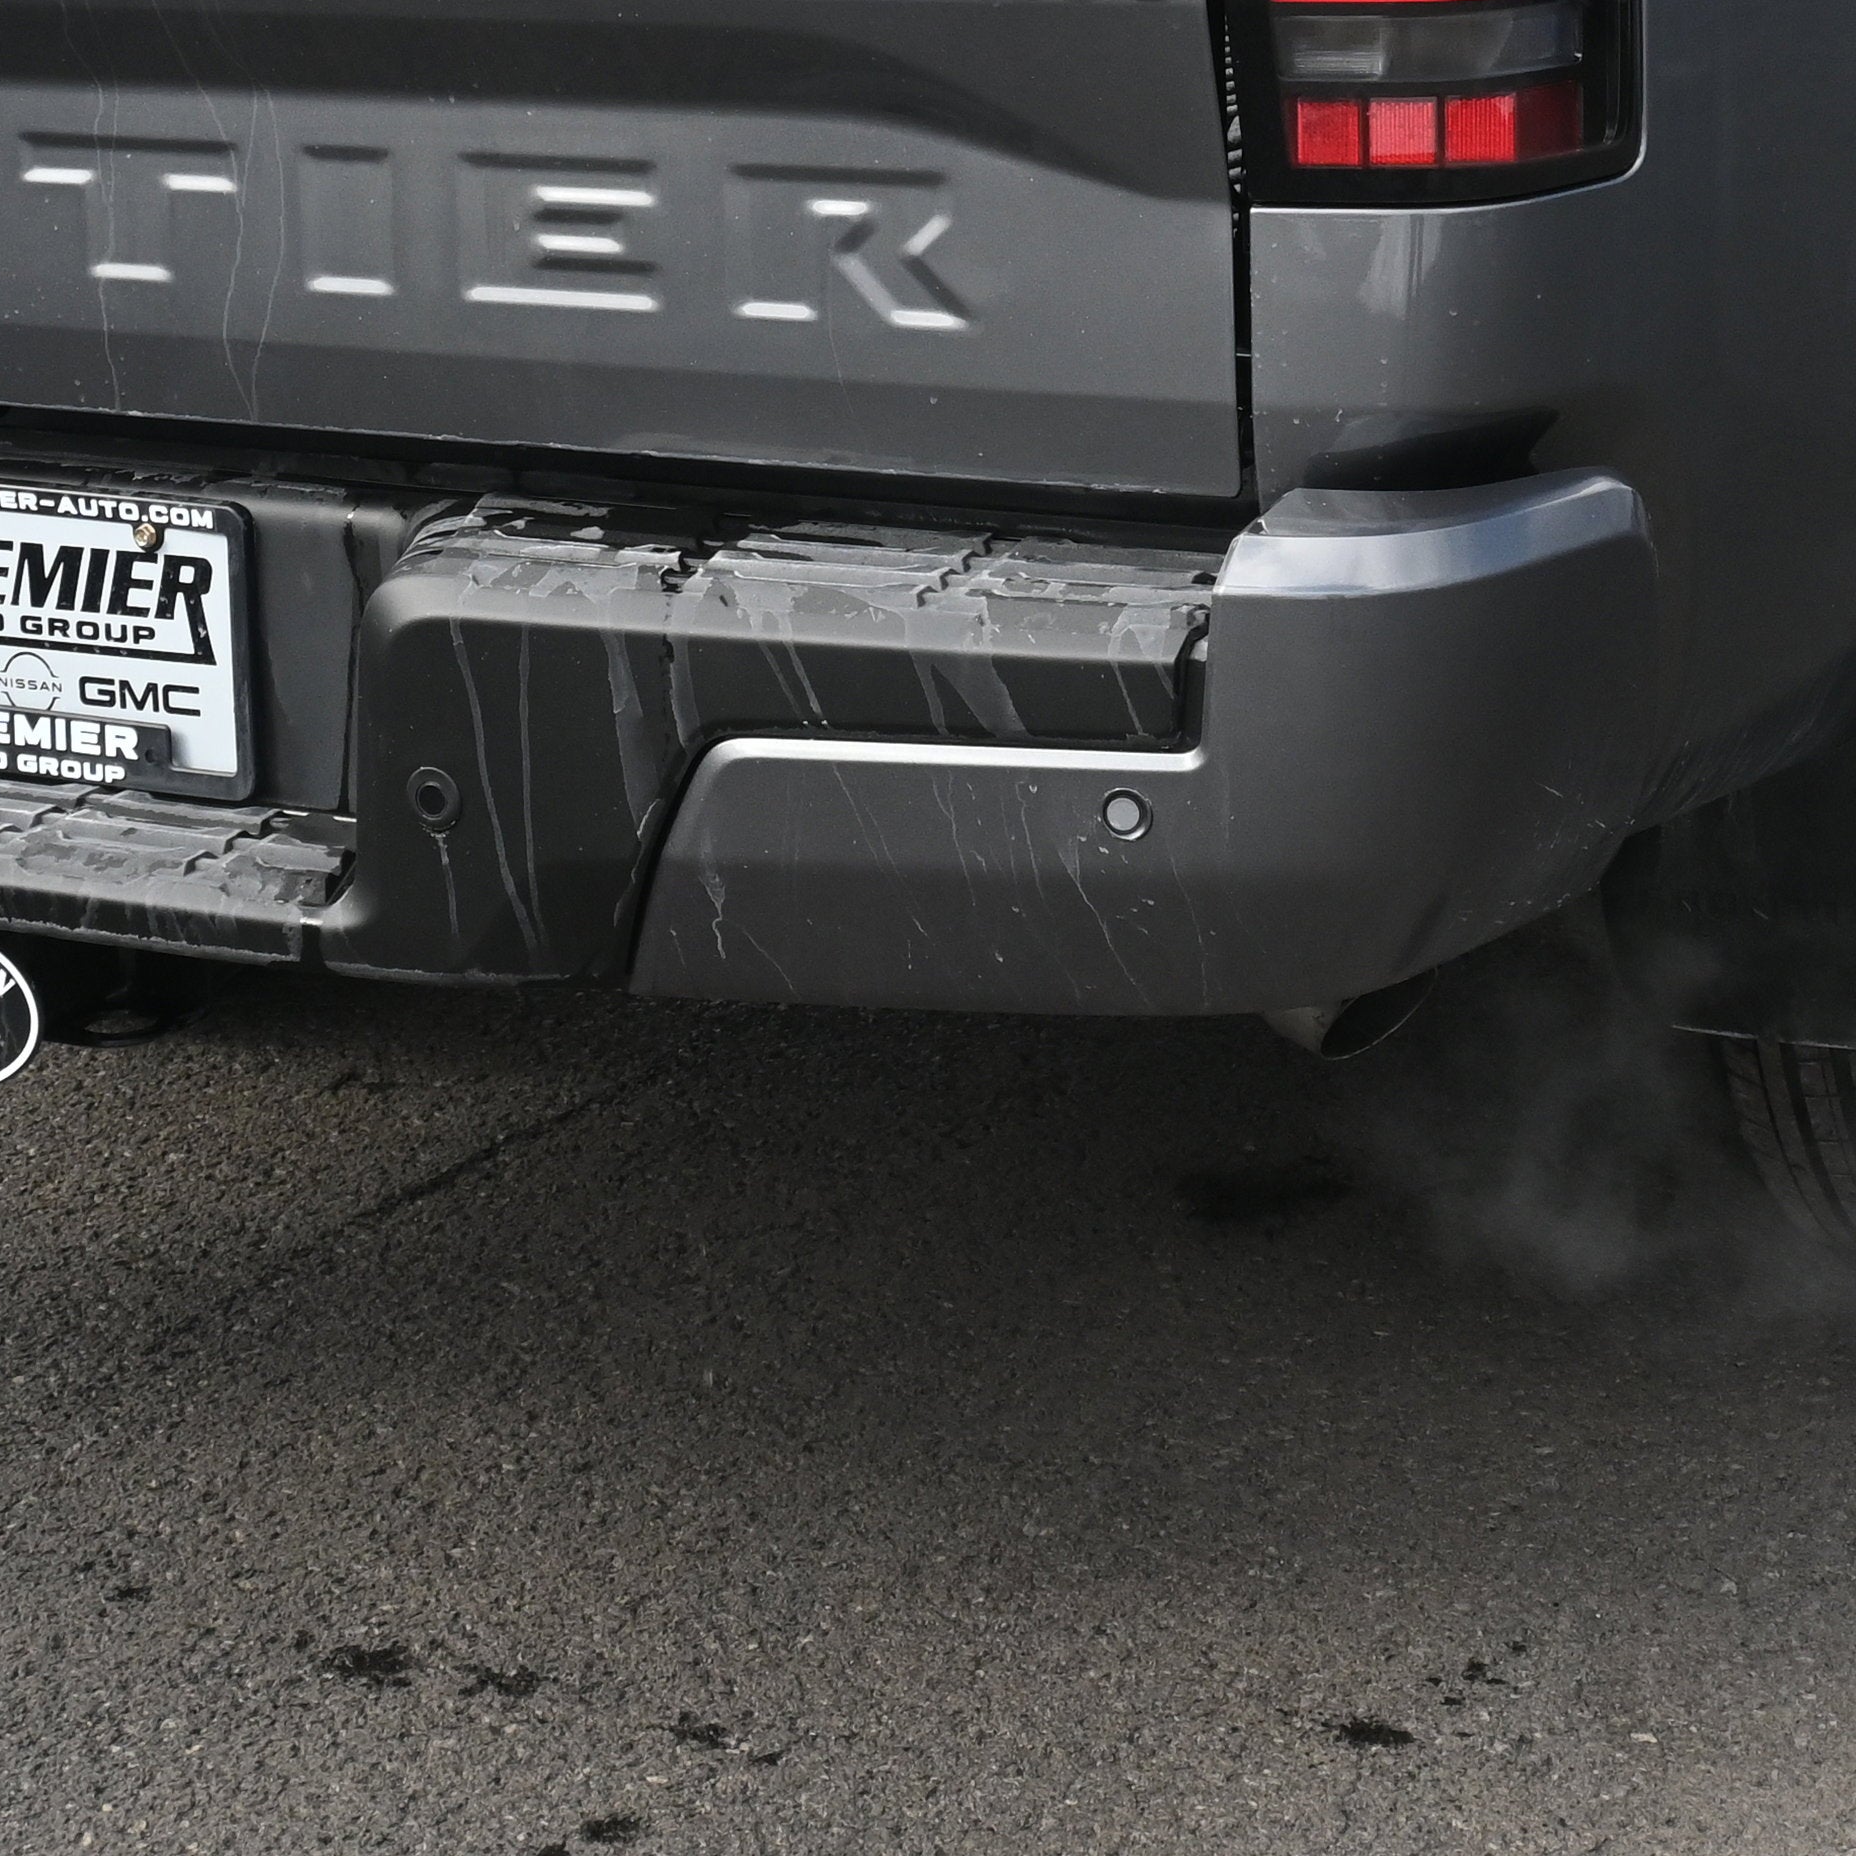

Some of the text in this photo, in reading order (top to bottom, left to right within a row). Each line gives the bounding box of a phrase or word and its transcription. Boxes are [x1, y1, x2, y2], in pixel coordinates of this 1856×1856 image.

[19, 615, 156, 645] GROUP
[78, 675, 202, 717] GMC
[16, 754, 126, 784] GROUP
